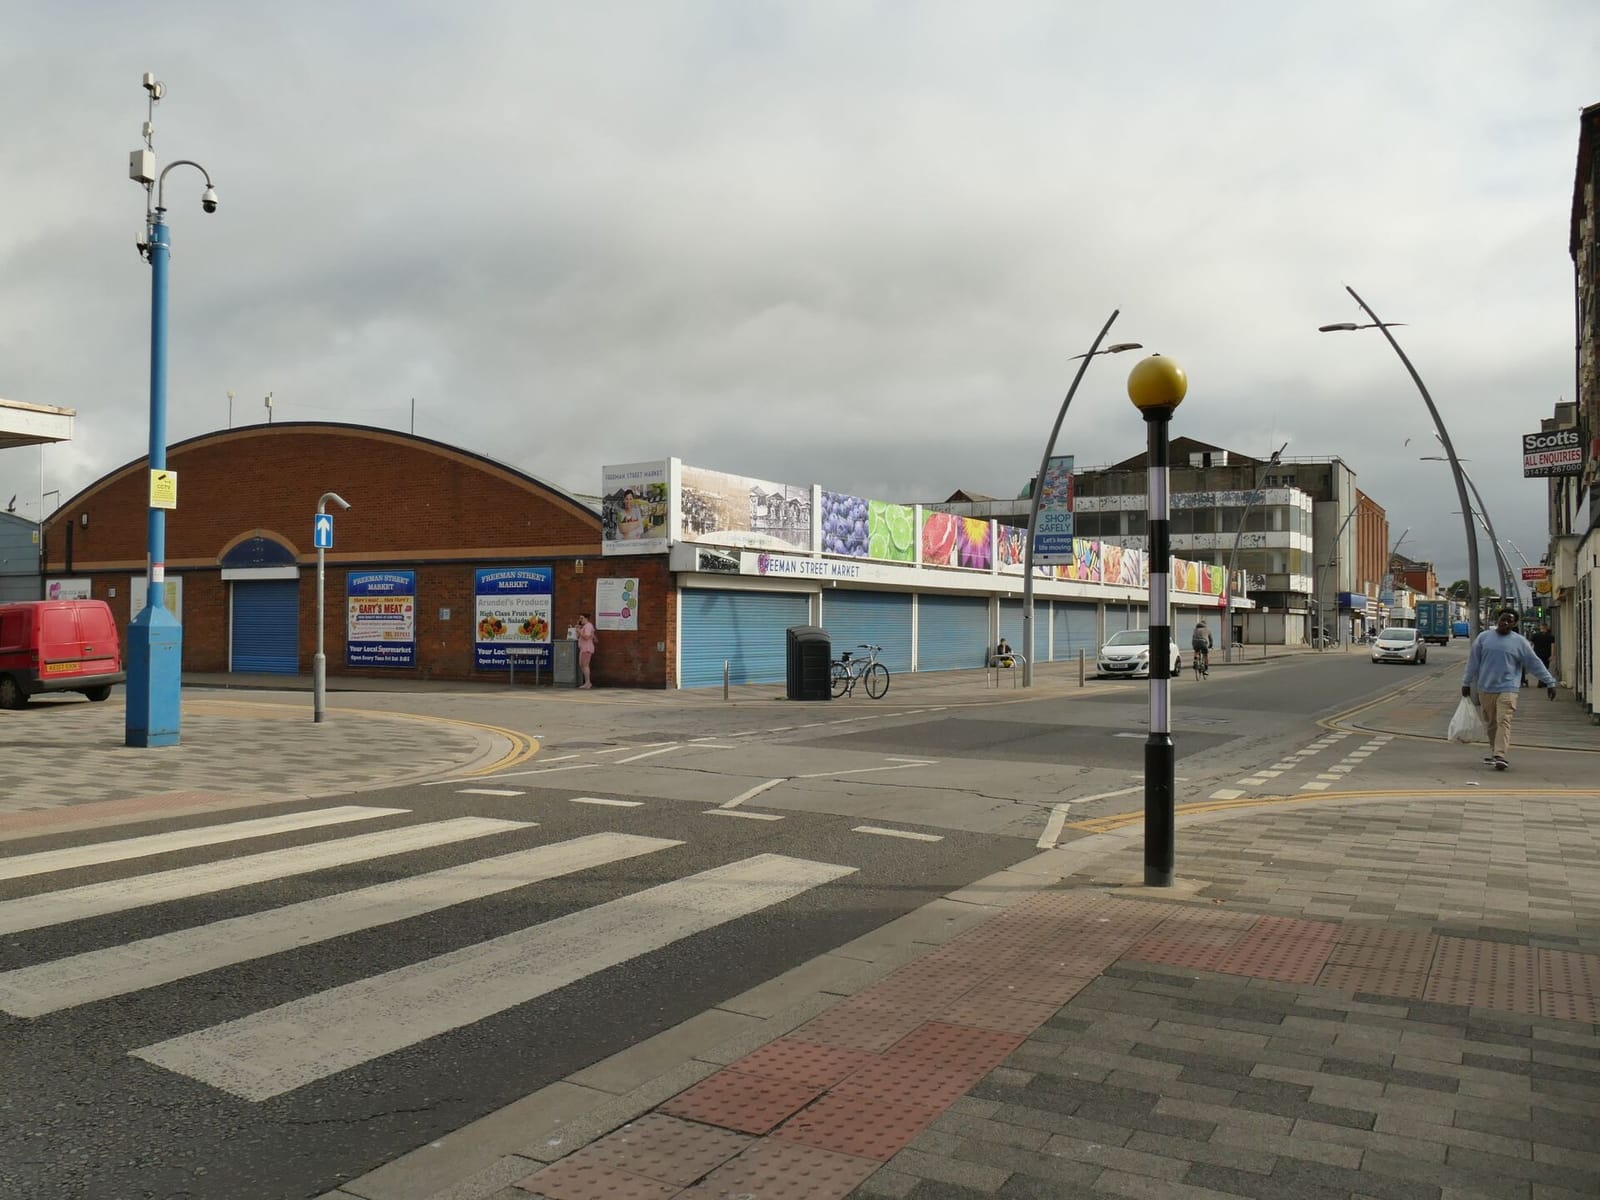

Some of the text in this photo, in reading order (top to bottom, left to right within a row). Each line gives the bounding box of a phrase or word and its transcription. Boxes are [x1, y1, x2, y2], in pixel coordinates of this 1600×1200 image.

[1525, 431, 1579, 449] Scotts
[1525, 450, 1581, 467] ALL ENQUIRIES
[1525, 464, 1582, 476] 01472 267000
[1045, 513, 1071, 523] SHOP
[1039, 523, 1071, 533] SAFELY
[800, 561, 828, 575] STREET
[832, 564, 860, 578] MARKET
[353, 575, 409, 586] FREEMAN STREET
[481, 571, 546, 583] FREEMAN STREET
[516, 598, 549, 606] Produce
[359, 604, 403, 614] GARY'S MEAT
